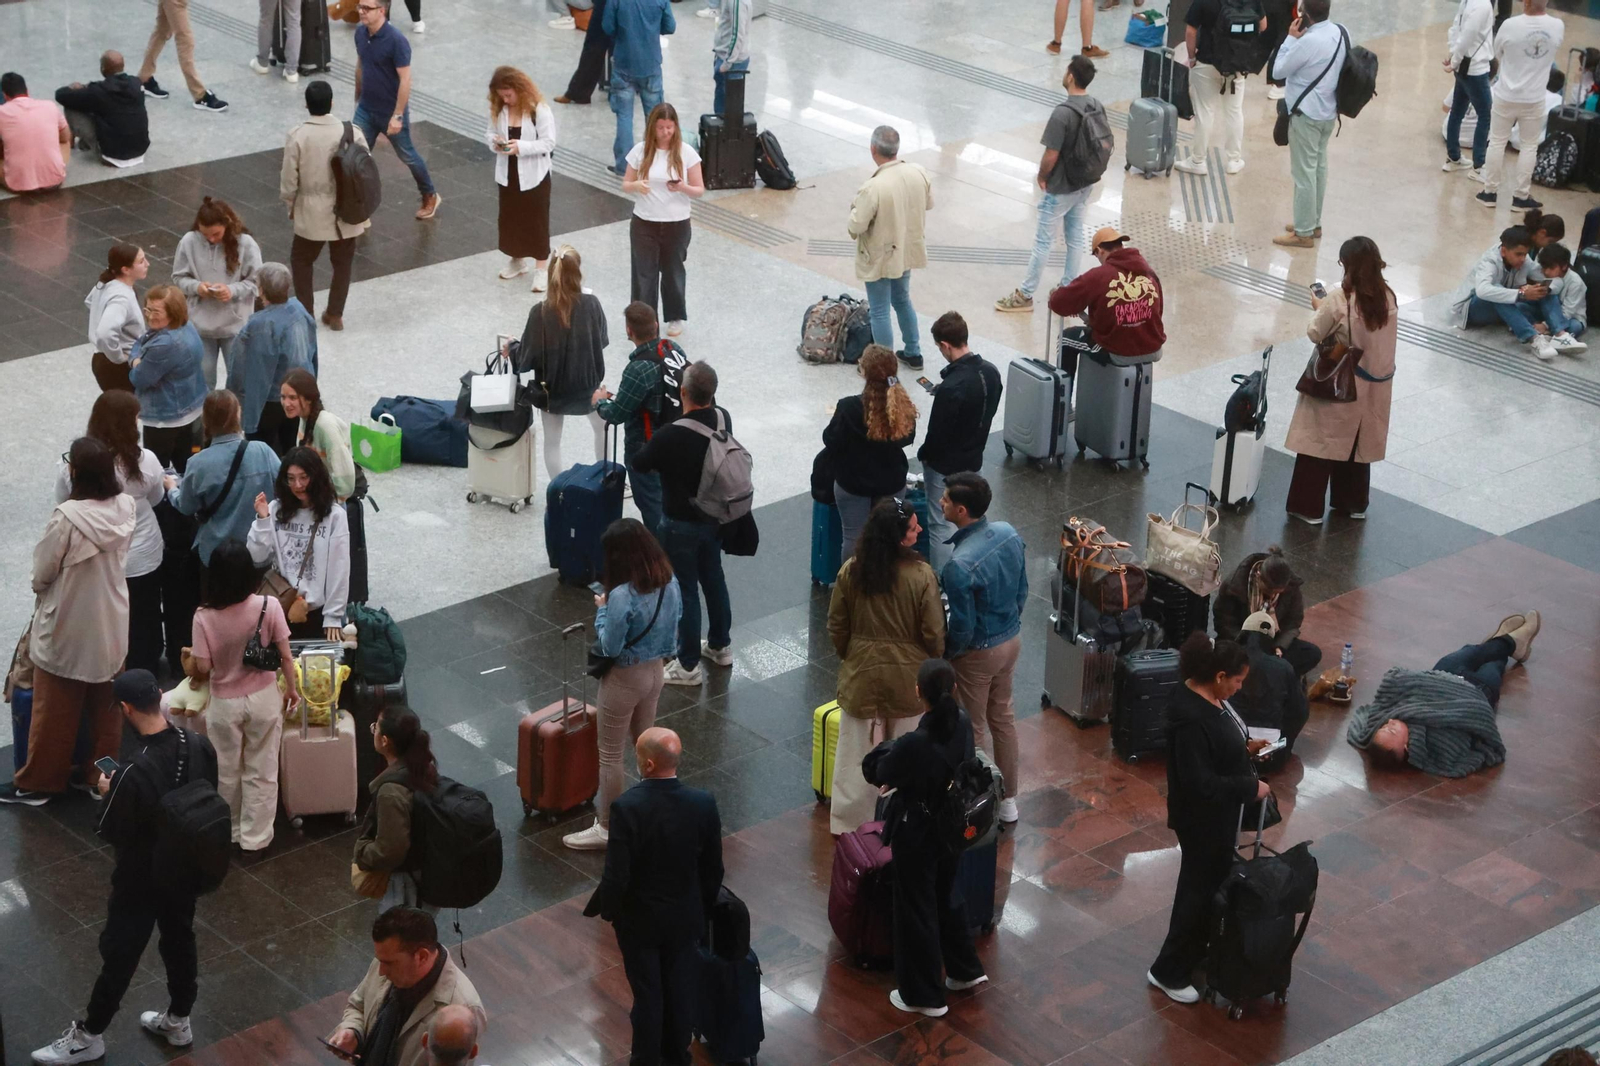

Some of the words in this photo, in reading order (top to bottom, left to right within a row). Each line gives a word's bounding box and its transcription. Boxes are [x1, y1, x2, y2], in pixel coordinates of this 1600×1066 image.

[1126, 308, 1152, 323] WAITING
[1164, 546, 1183, 560] THE
[1173, 561, 1197, 576] BAG
